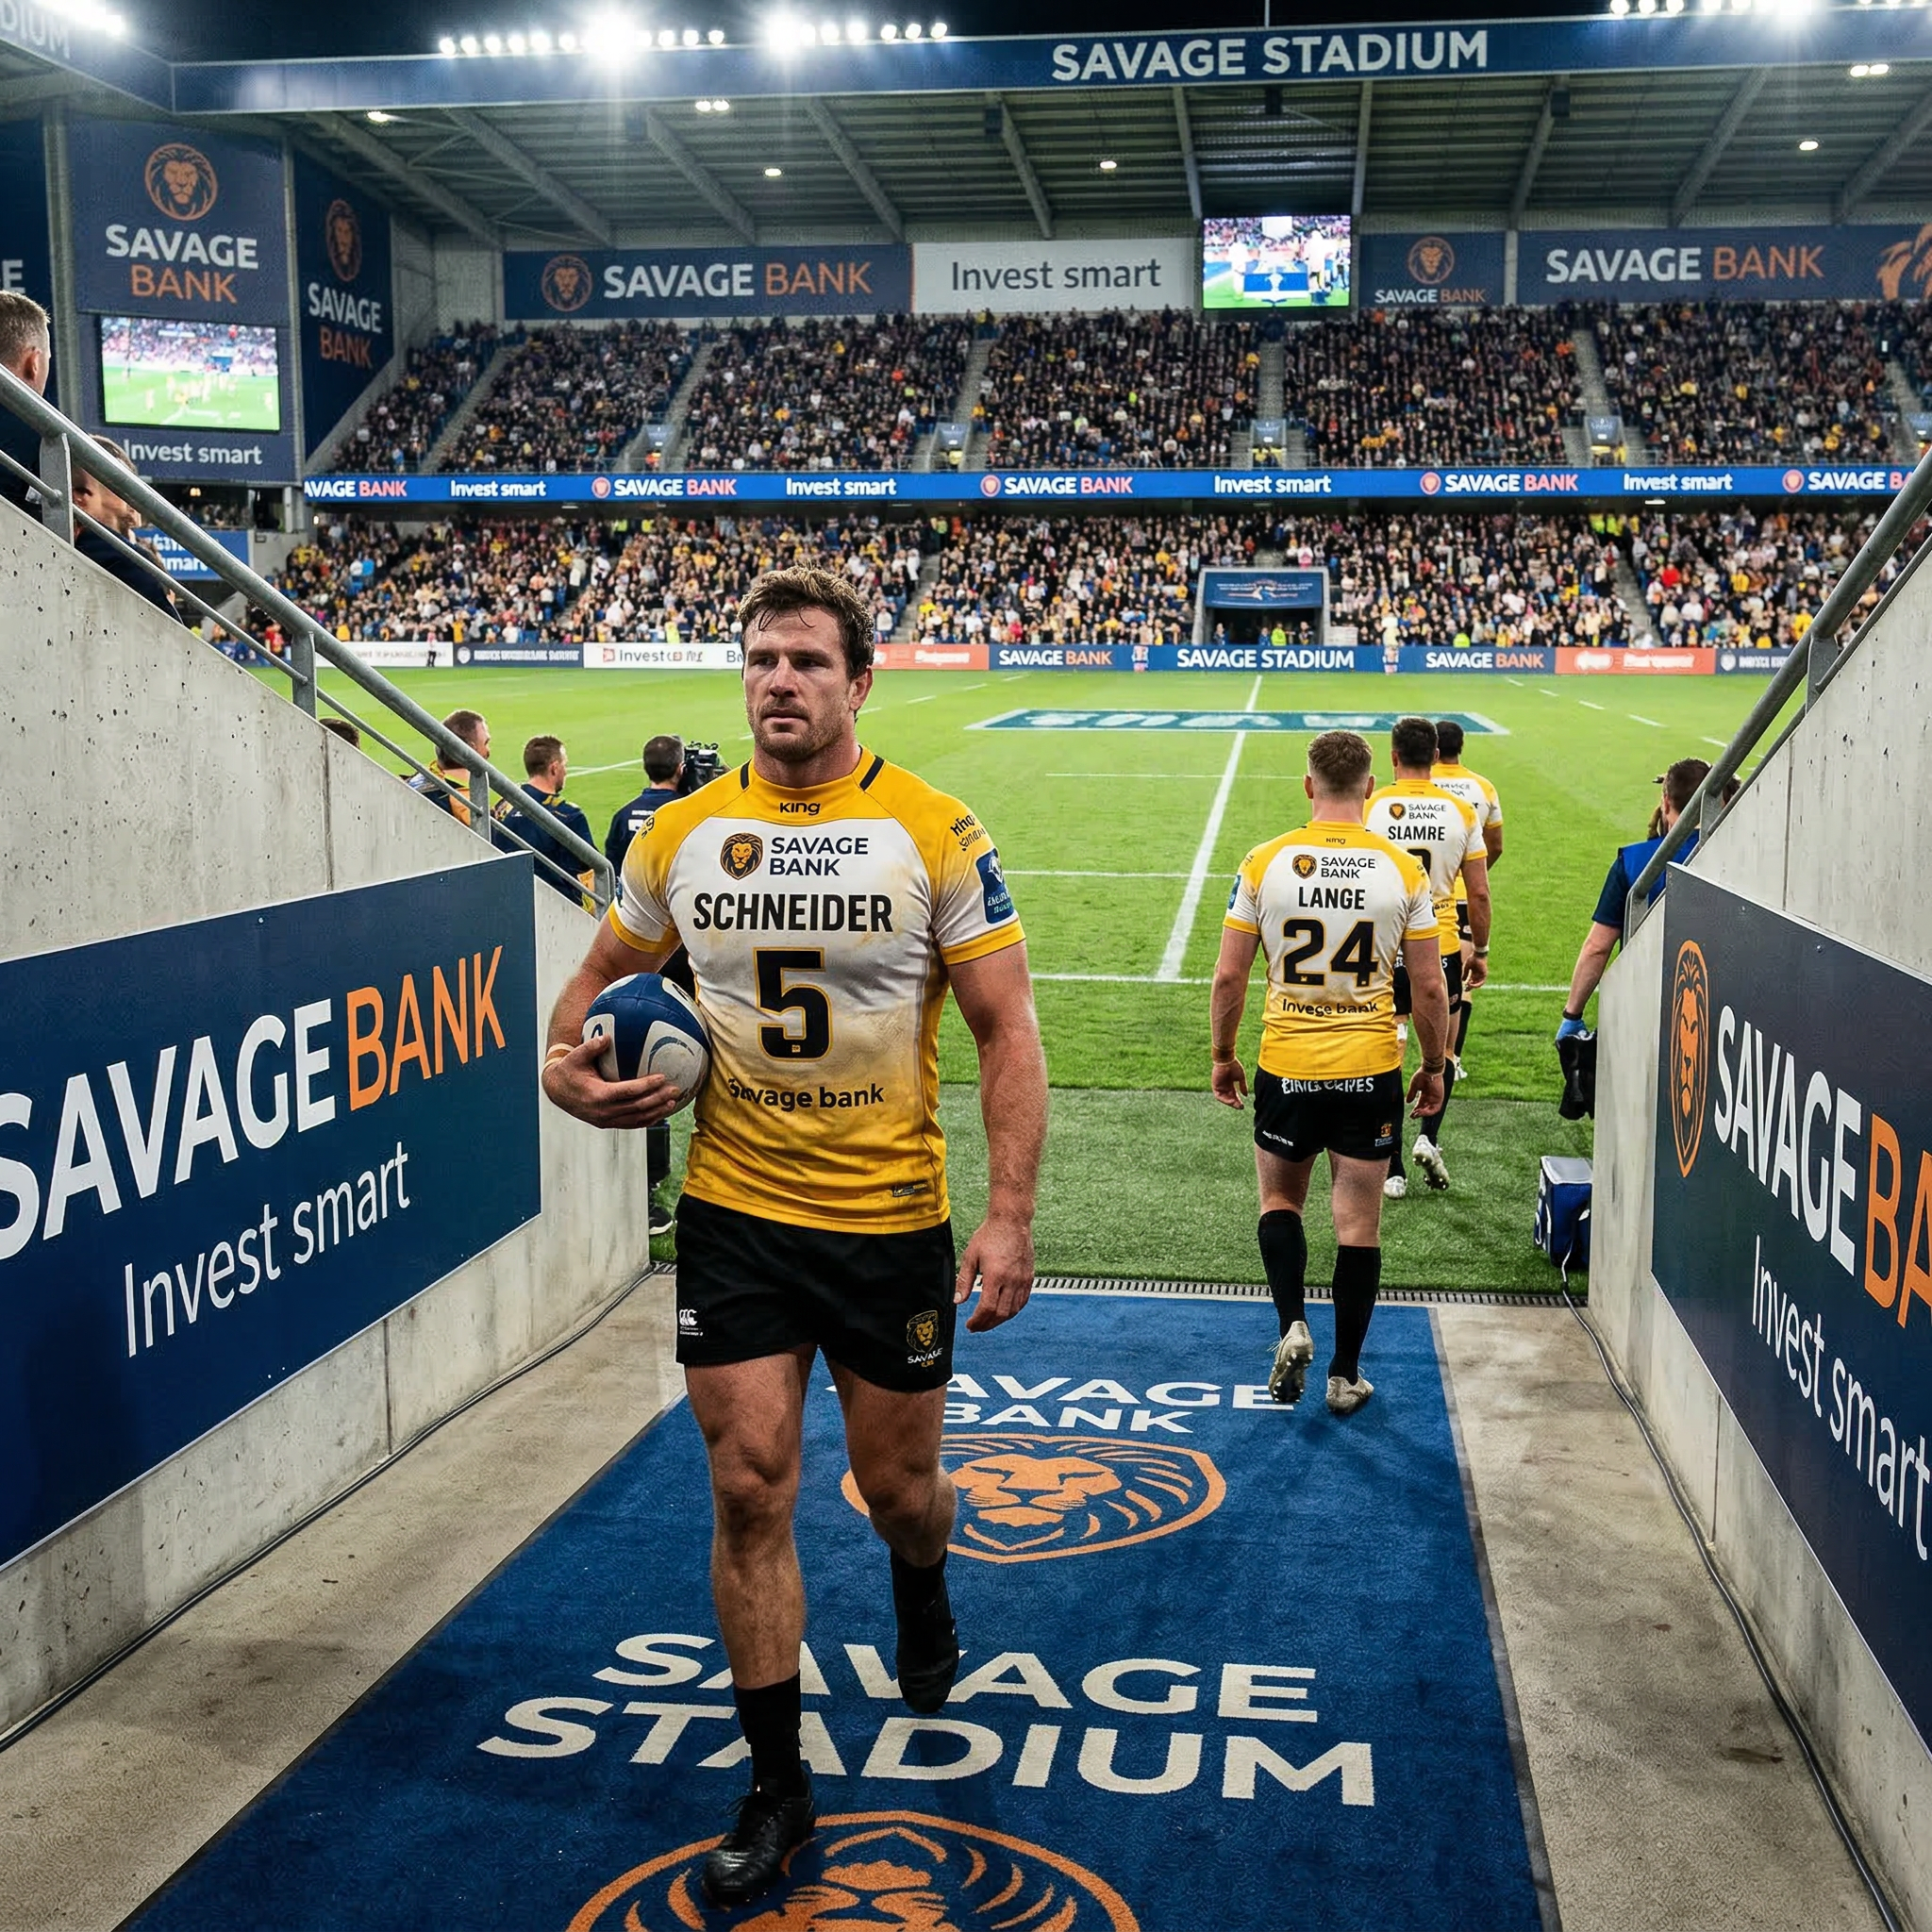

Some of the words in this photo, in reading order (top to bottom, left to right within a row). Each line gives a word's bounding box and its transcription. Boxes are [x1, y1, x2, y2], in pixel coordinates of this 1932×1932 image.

[1052, 39, 1246, 81] SAVAGE
[1262, 30, 1487, 74] STADIUM
[106, 225, 258, 270] SAVAGE
[952, 261, 1053, 291] Invest
[1064, 258, 1160, 288] smart
[1546, 248, 1701, 283] SAVAGE
[1712, 246, 1824, 279] BANK
[131, 265, 237, 304] BANK
[604, 263, 754, 298] SAVAGE
[765, 262, 872, 295] BANK
[1374, 289, 1437, 304] SAVAGE
[1441, 289, 1486, 303] BANK
[308, 283, 383, 333] SAVAGE
[319, 328, 373, 369] BANK
[124, 439, 193, 462] Invest
[198, 445, 262, 465] smart
[358, 480, 407, 497] BANK
[451, 480, 499, 496] Invest
[501, 480, 546, 496] smart
[614, 479, 683, 496] SAVAGE
[687, 479, 737, 495] BANK
[787, 478, 841, 495] Invest
[844, 478, 896, 495] smart
[1005, 476, 1076, 494] SAVAGE
[1081, 476, 1132, 493] BANK
[1214, 475, 1274, 493] Invest
[1276, 475, 1331, 492] smart
[1445, 474, 1520, 492] SAVAGE
[1524, 474, 1578, 491] BANK
[1624, 474, 1678, 491] Invest
[1680, 474, 1733, 491] smart
[1807, 472, 1886, 490] SAVAGE
[999, 650, 1063, 666] SAVAGE
[1065, 651, 1112, 665] BANK
[1177, 648, 1257, 668] SAVAGE
[1261, 649, 1354, 669] STADIUM
[1425, 652, 1492, 668] SAVAGE
[1495, 653, 1543, 668] BANK
[1408, 804, 1446, 812] SAVAGE
[1388, 825, 1446, 841] SLAMRE
[771, 837, 869, 855] SAVAGE
[769, 858, 841, 876] BANK
[1321, 857, 1375, 869] SAVAGE
[1321, 868, 1360, 878] BANK
[1299, 887, 1365, 909] LANGE
[693, 892, 893, 932] SCHNEIDER
[1282, 917, 1379, 988] 24
[754, 947, 834, 1062] 5
[347, 945, 506, 1111] BANK
[819, 1083, 884, 1108] bank
[1714, 1005, 1861, 1276] SAVAGE
[125, 1204, 280, 1357] Invest
[292, 1141, 410, 1265] smart
[1752, 1234, 1824, 1418] Invest
[1829, 1357, 1930, 1560] smart
[942, 1403, 1193, 1433] BANK
[475, 1695, 1376, 1807] STADIUM
